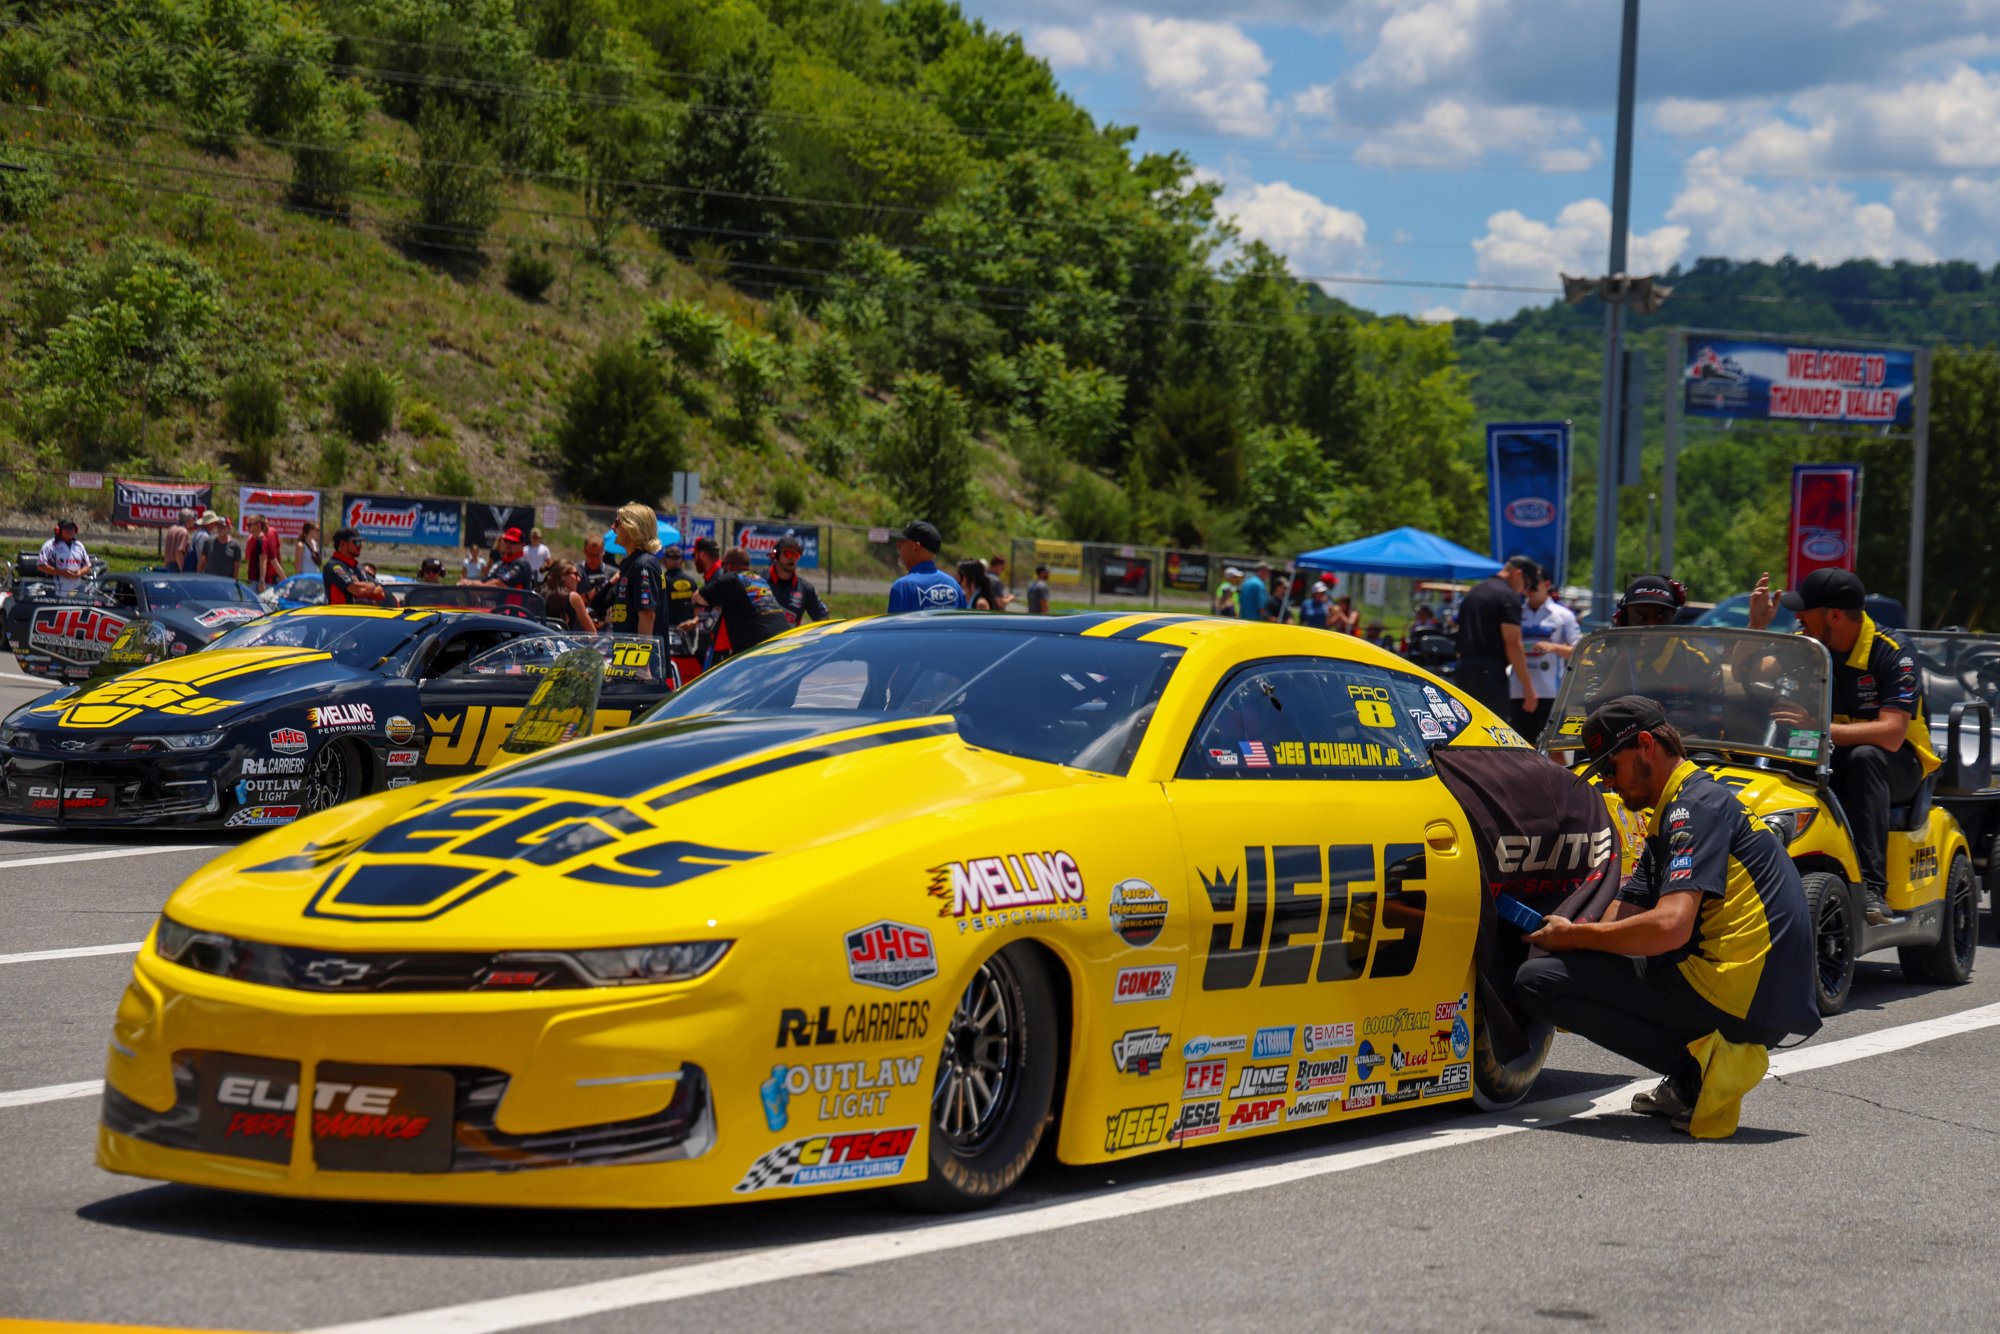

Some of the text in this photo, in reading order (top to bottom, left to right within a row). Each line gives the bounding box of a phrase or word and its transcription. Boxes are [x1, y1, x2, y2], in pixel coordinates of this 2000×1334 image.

[1787, 347, 1887, 386] WELCOME TO
[1769, 384, 1842, 419] THUNDER
[1843, 388, 1900, 420] VALLEY
[123, 490, 193, 508] LINCOLN
[930, 587, 955, 602] RFC
[35, 609, 126, 643] JHG
[612, 650, 651, 667] 10
[613, 642, 653, 651] PRO
[1346, 685, 1389, 701] PRO
[316, 703, 374, 728] MELLING
[1354, 700, 1396, 729] 8
[272, 730, 305, 745] JHG
[317, 724, 376, 735] PERFORMANCE
[268, 758, 305, 774] CARRIERS
[1274, 741, 1306, 766] JEG
[1309, 742, 1381, 767] COUGHLIN
[1384, 748, 1401, 767] JR
[28, 786, 96, 799] ELITE
[246, 779, 302, 791] OUTLAW
[259, 791, 288, 801] LIGHT
[1495, 827, 1612, 873] ELITE
[953, 850, 1086, 917] MELLING
[1122, 888, 1154, 899] HIGH
[957, 904, 1088, 935] PERFORMANCE
[1112, 903, 1167, 914] PERFORMANCE
[1196, 843, 1427, 992] JEGS
[851, 927, 930, 963] JHG
[1117, 970, 1162, 996] COMP
[843, 998, 931, 1044] CARRIERS
[1314, 1024, 1354, 1040] BMRS
[1363, 1008, 1430, 1037] GOODYEAR
[1256, 1029, 1291, 1056] STROUD
[785, 1056, 924, 1095] OUTLAW
[1186, 1063, 1225, 1090] CFE
[1297, 1055, 1348, 1079] Browell
[217, 1076, 398, 1116] ELITE
[1345, 1097, 1373, 1110] WELDERS
[1350, 1083, 1385, 1099] LINCOLN
[818, 1090, 891, 1121] LIGHT
[1229, 1100, 1286, 1126] ARP
[1104, 1103, 1169, 1154] JEGS
[800, 1159, 900, 1181] MANUFACTURING
